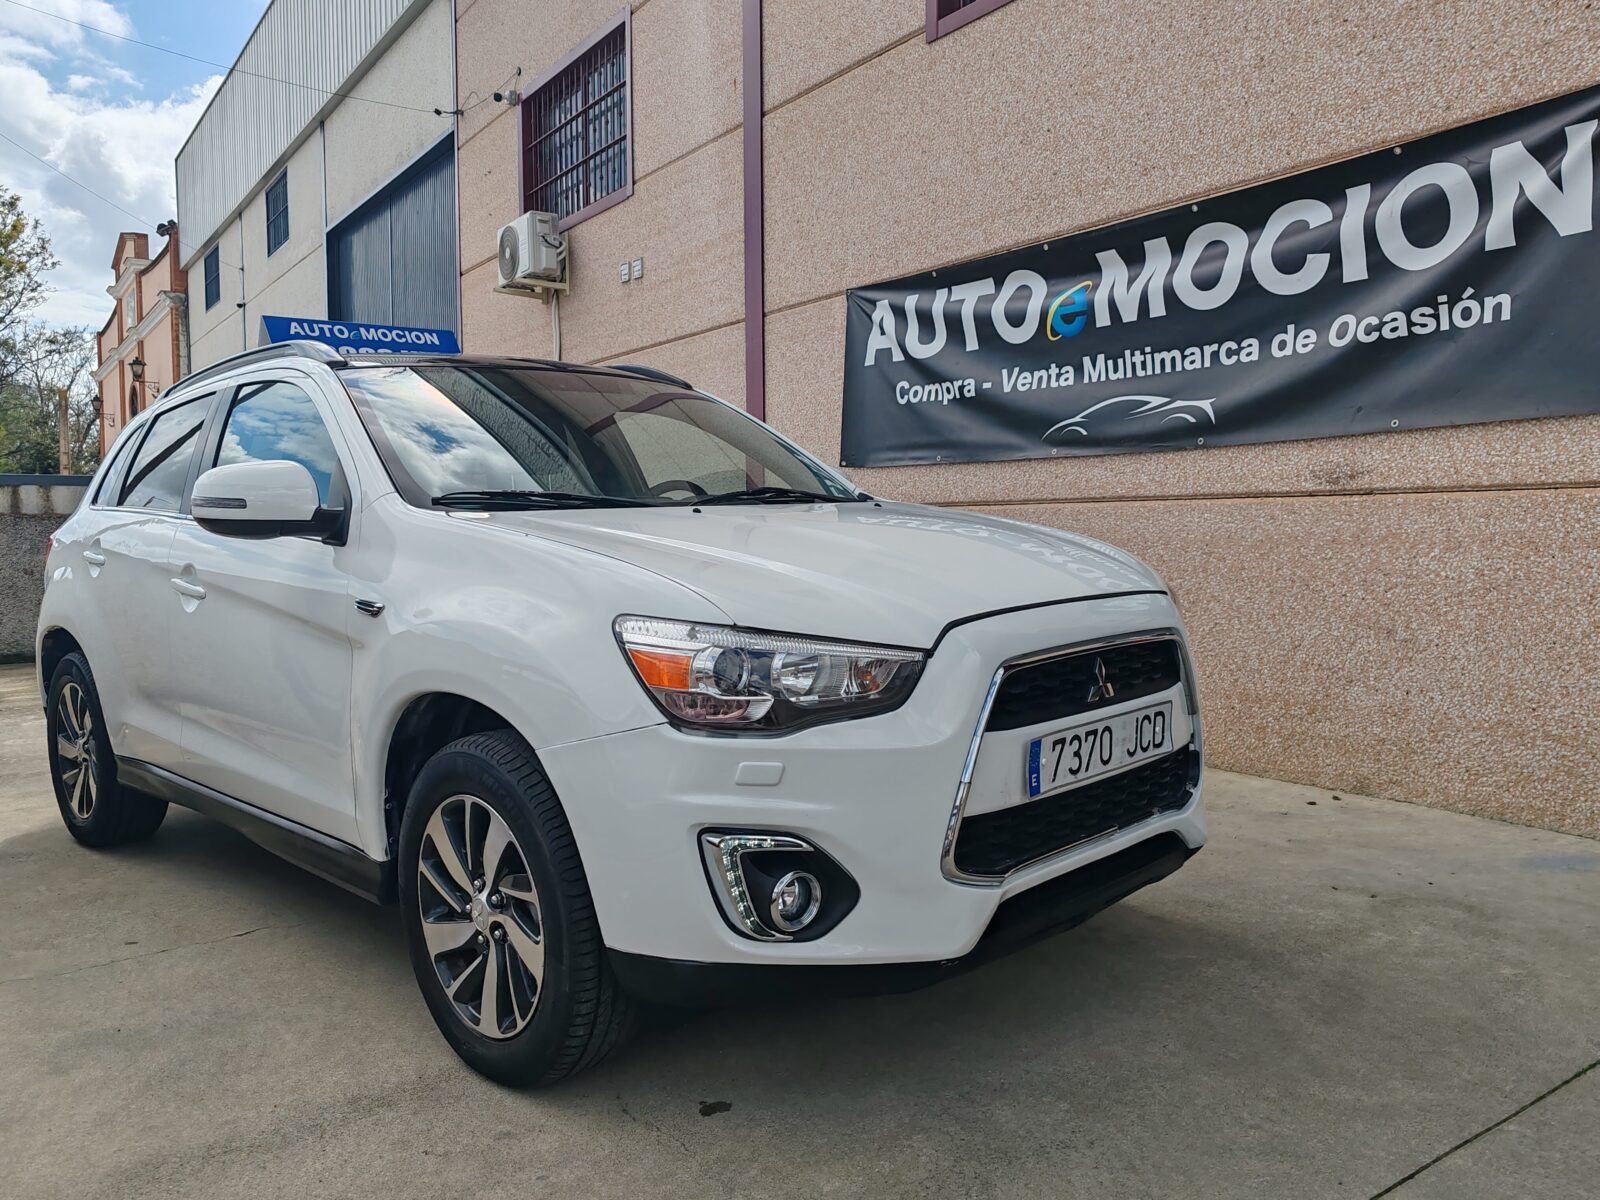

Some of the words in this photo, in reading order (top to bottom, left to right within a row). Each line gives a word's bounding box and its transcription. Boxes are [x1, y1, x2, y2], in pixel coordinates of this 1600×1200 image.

[895, 377, 976, 405] Compra
[1001, 363, 1074, 393] Venta
[1082, 346, 1259, 384] Multimarca
[1271, 323, 1317, 358] de
[1328, 286, 1512, 348] Ocasión
[1051, 725, 1113, 783] 7370
[1127, 711, 1166, 757] JCD
